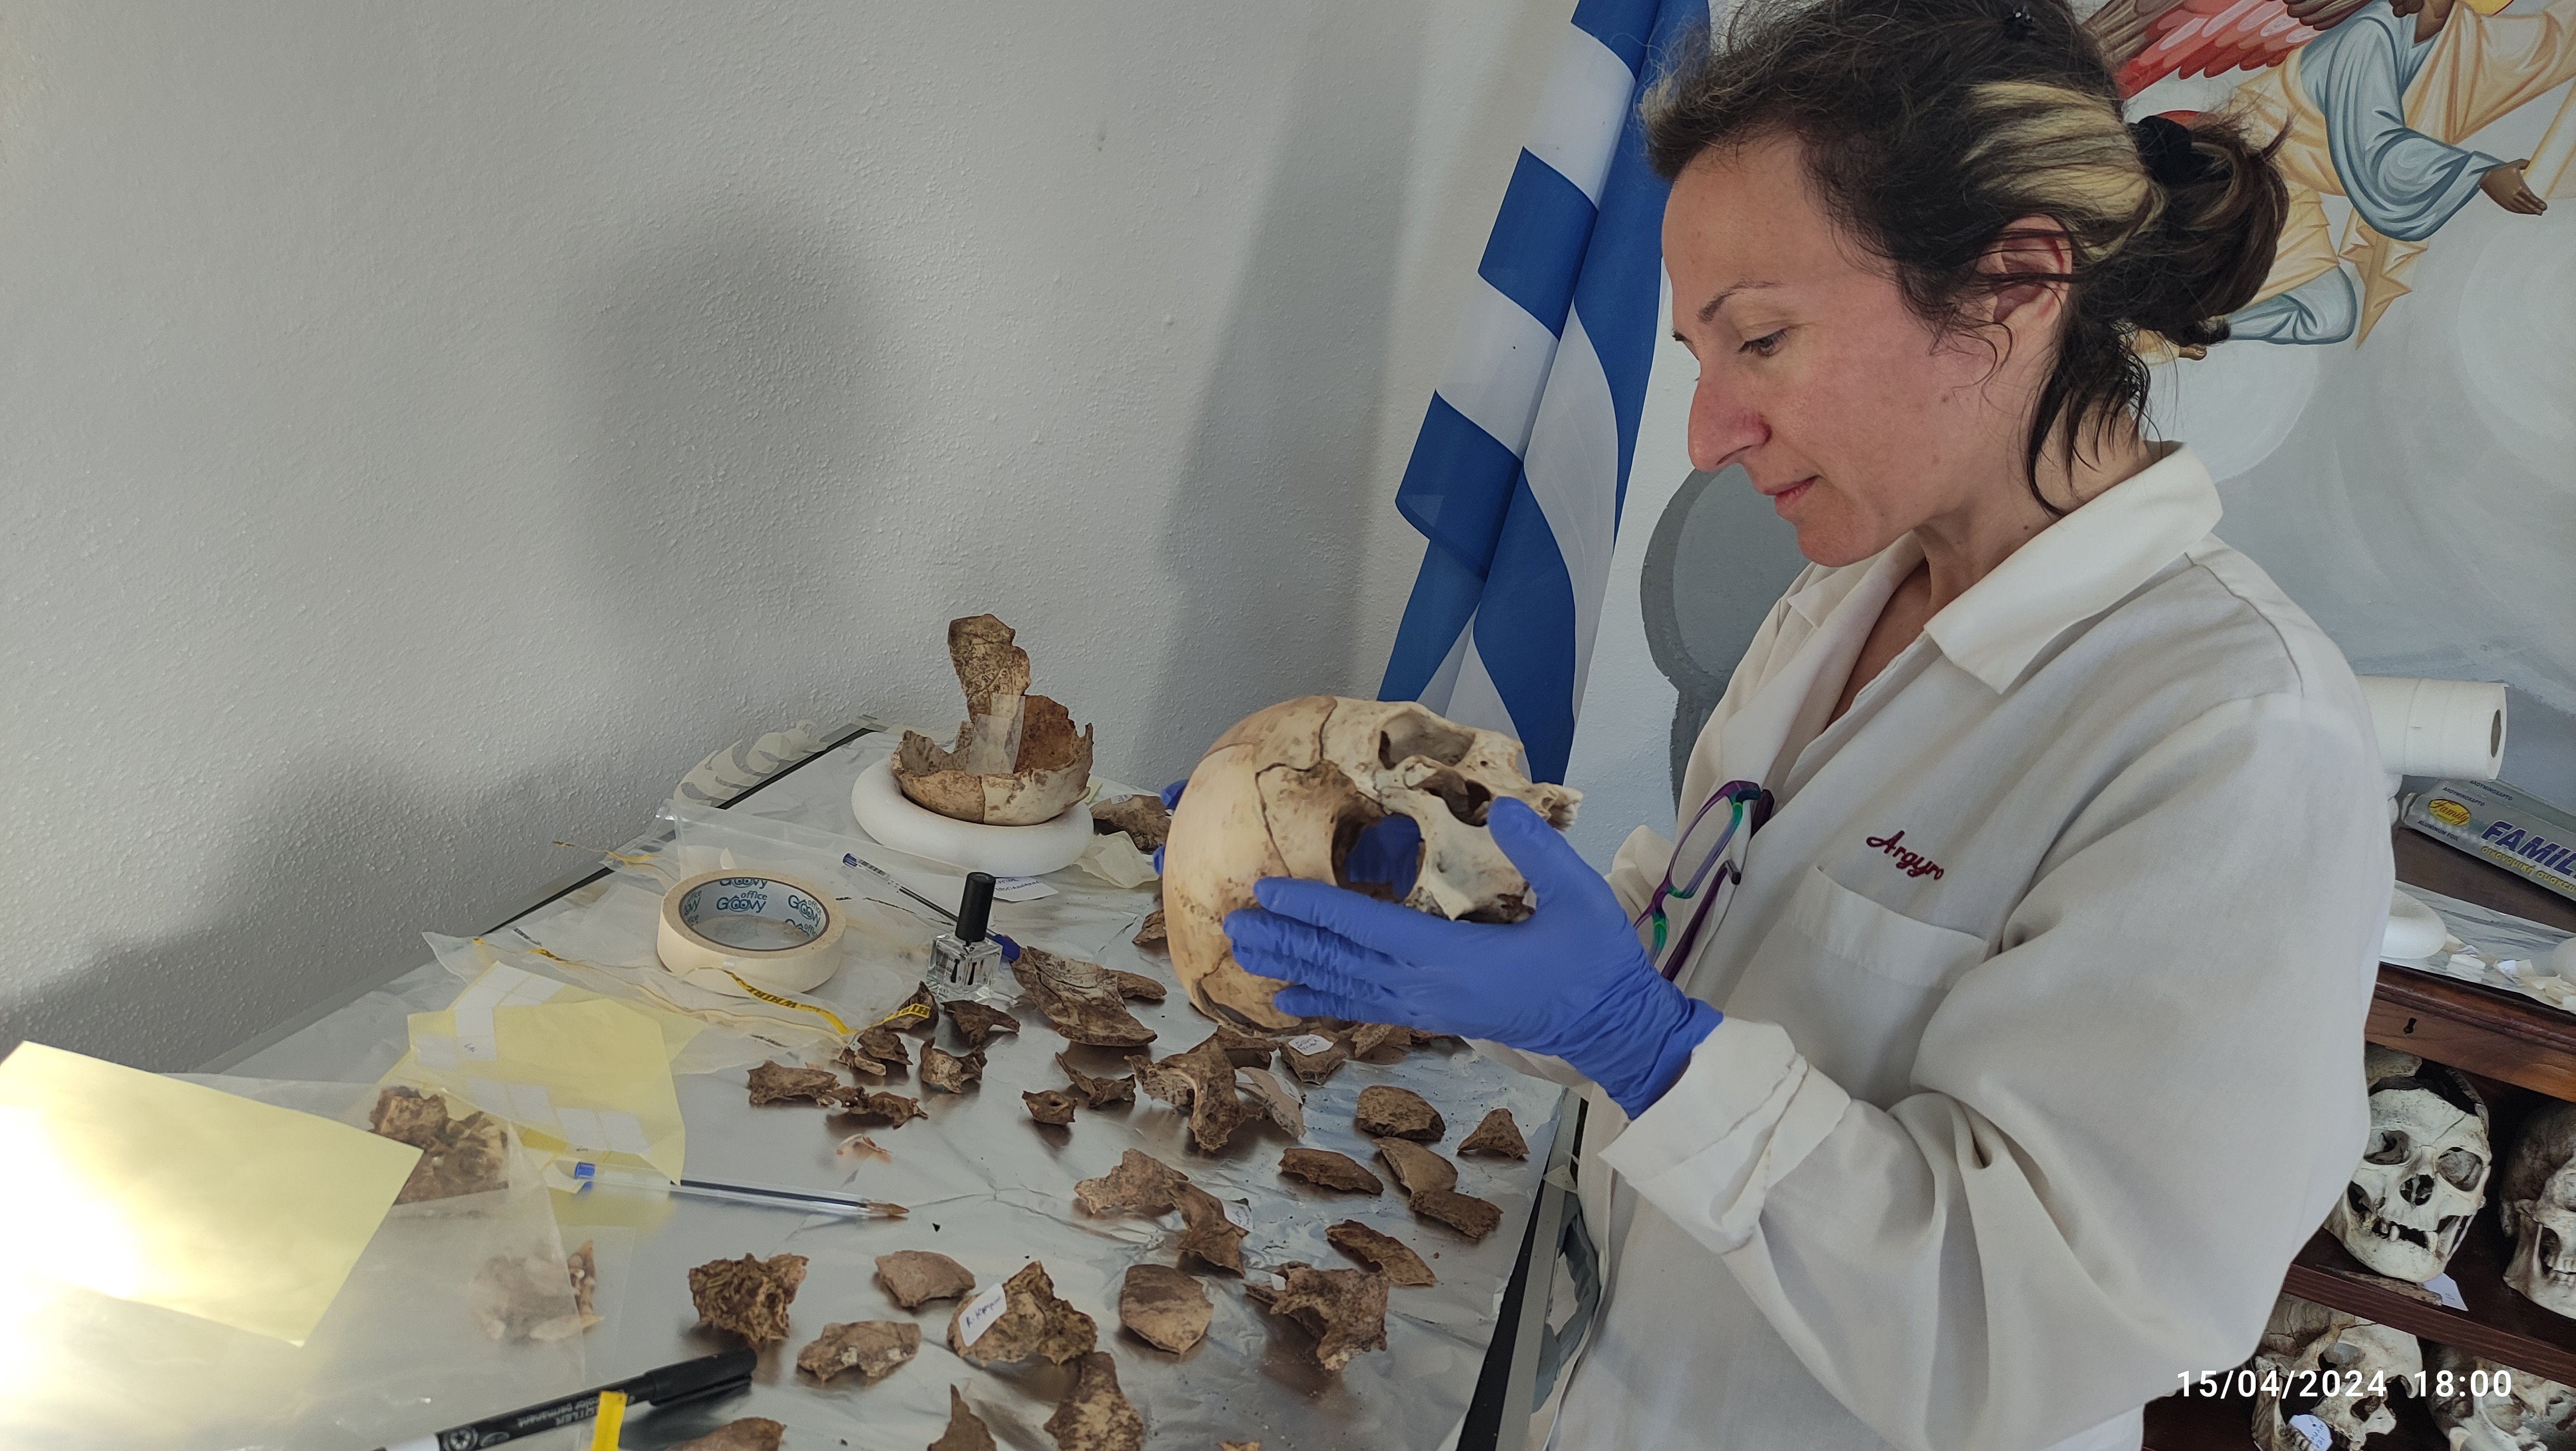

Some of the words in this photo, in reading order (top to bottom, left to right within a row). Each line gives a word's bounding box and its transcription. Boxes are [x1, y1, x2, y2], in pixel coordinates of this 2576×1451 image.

[2429, 800, 2470, 825] Family
[2418, 820, 2447, 836] ALUMINUM
[2447, 832, 2458, 841] FOIL
[2481, 820, 2576, 879] FAMIL
[741, 891, 768, 900] office
